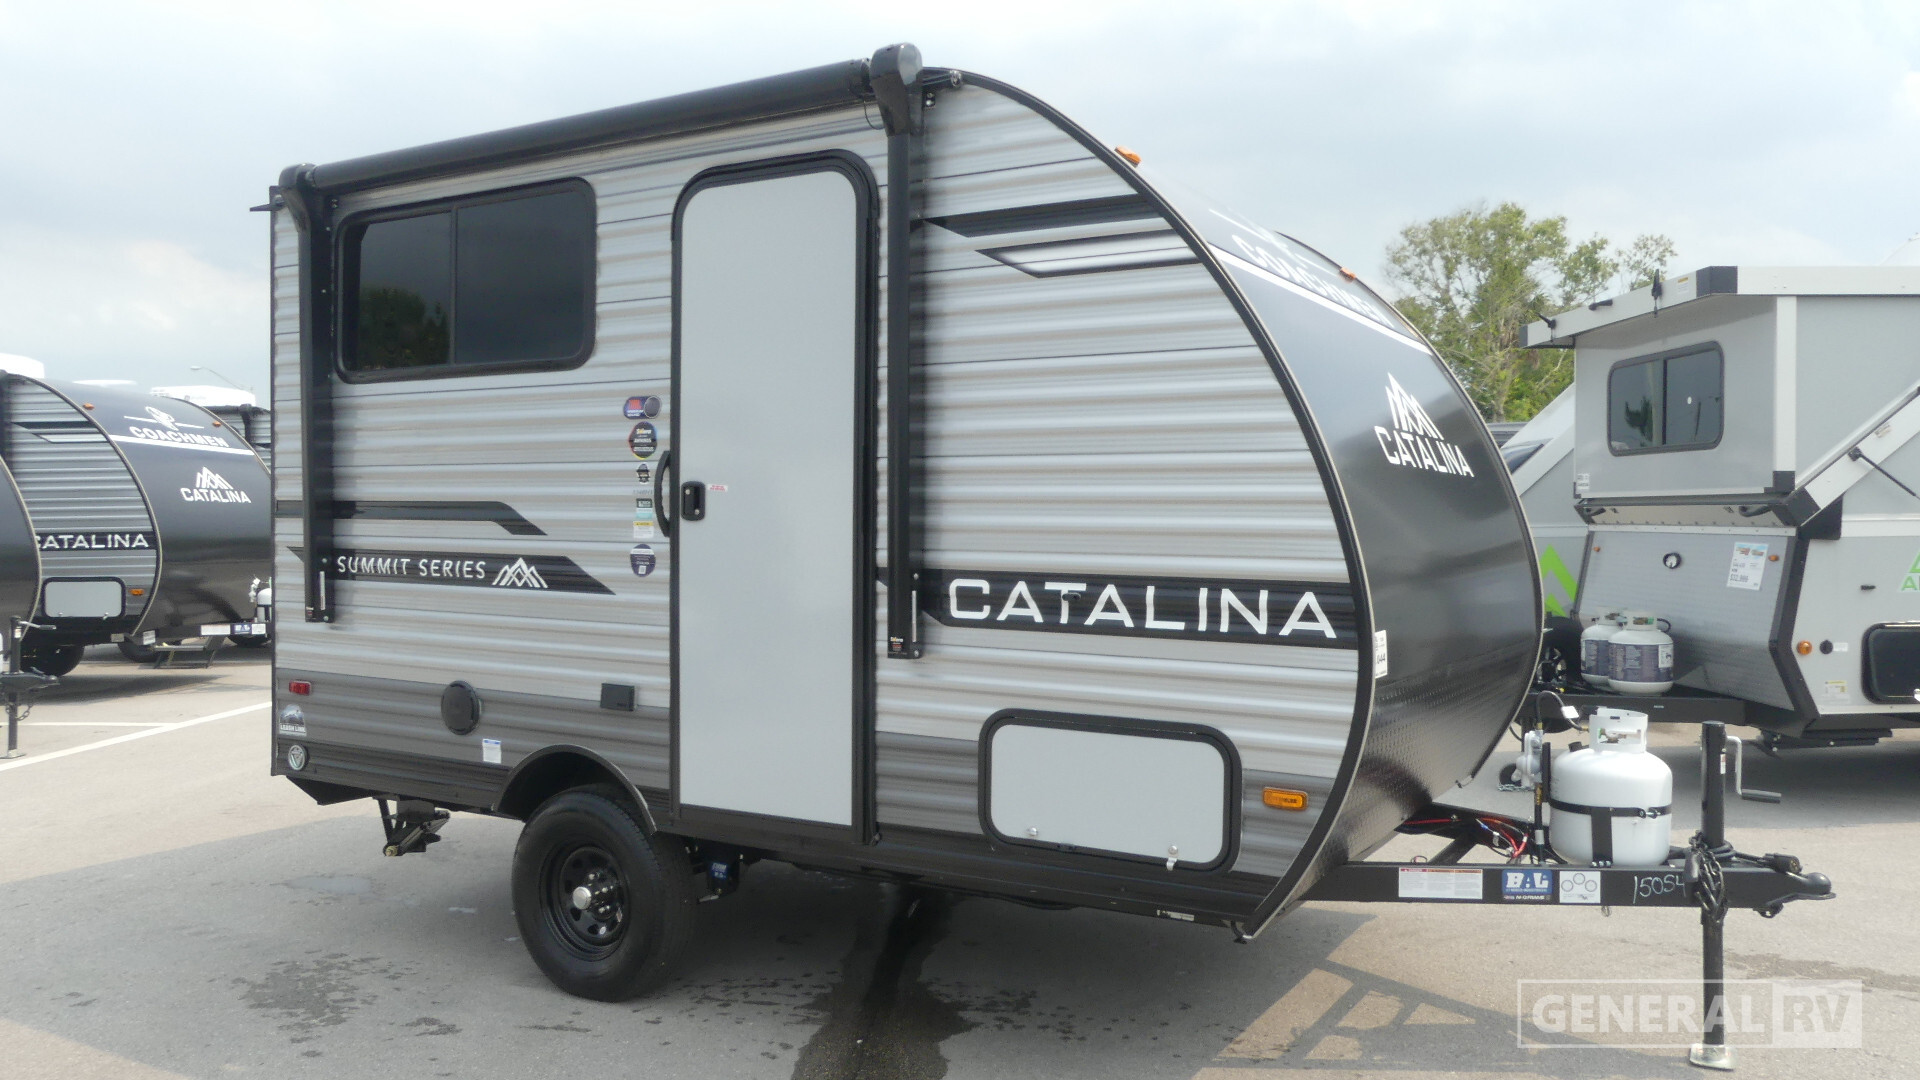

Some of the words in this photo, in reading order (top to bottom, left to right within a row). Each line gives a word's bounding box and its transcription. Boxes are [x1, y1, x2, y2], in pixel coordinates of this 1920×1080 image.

[129, 426, 230, 448] COACHMEN
[1374, 425, 1475, 478] CATALINA
[180, 487, 252, 504] CATALINA
[337, 555, 411, 575] SUMMIT
[418, 558, 487, 579] SERIES
[948, 578, 1338, 640] CATALINA
